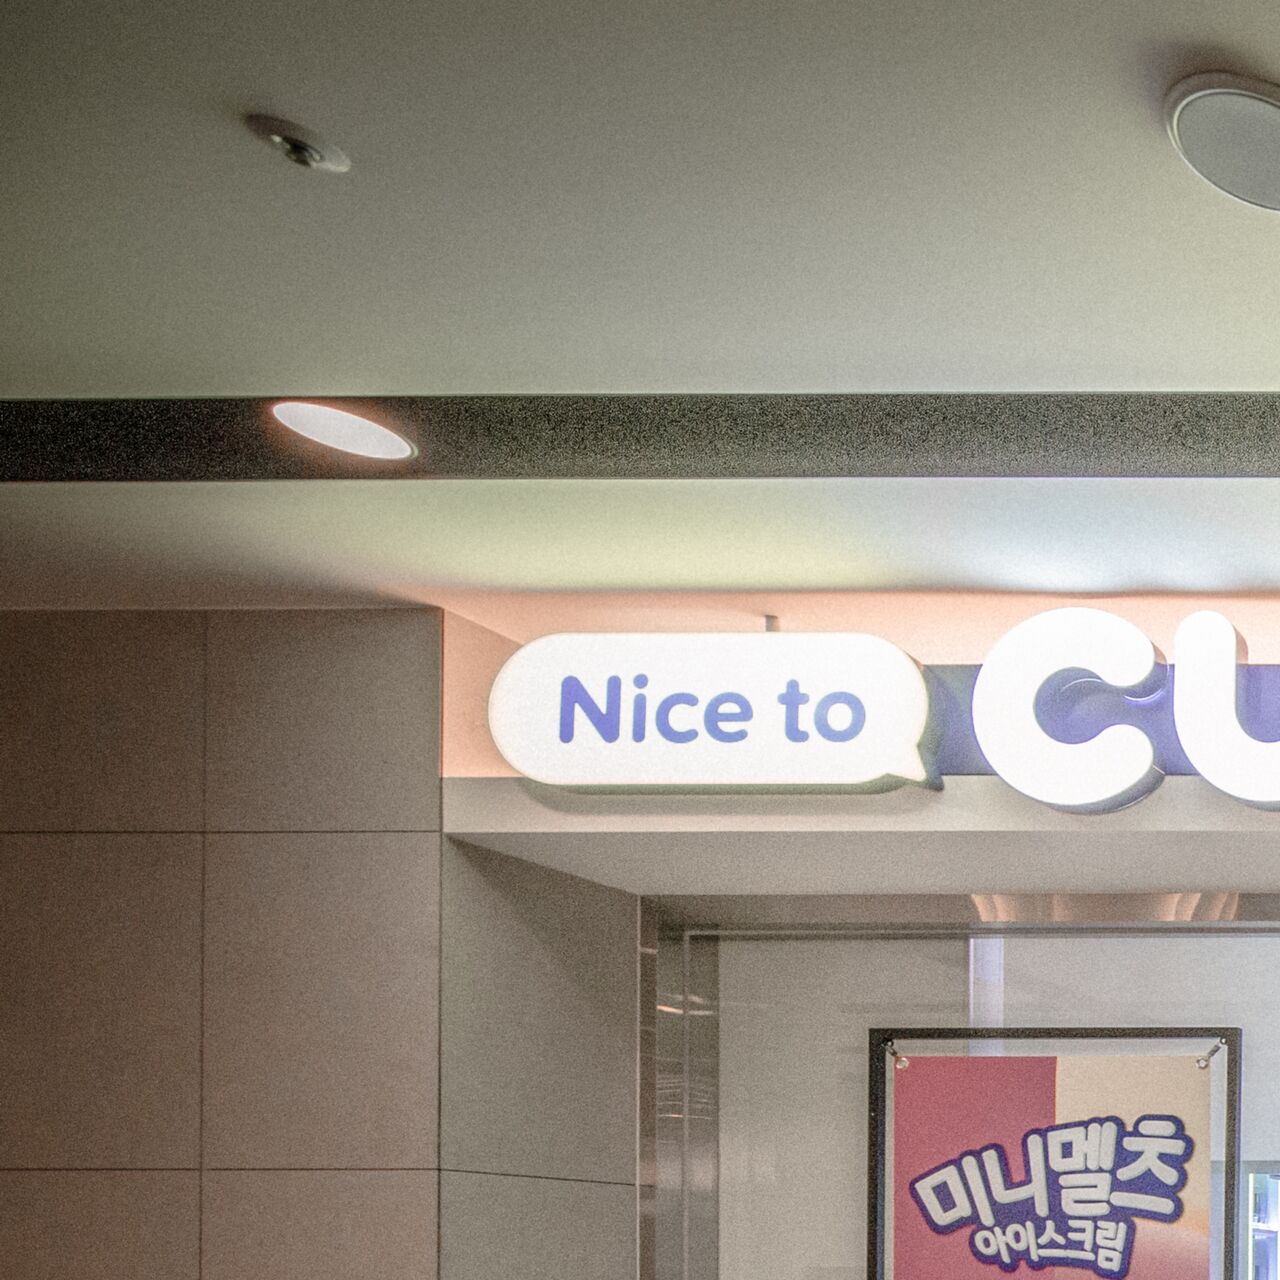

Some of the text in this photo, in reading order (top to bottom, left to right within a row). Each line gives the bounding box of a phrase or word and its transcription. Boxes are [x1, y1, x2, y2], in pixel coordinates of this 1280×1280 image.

[558, 674, 868, 745] Nice to
[912, 1116, 1190, 1231] 미니멜츠
[973, 1218, 1128, 1273] 아이스크림
